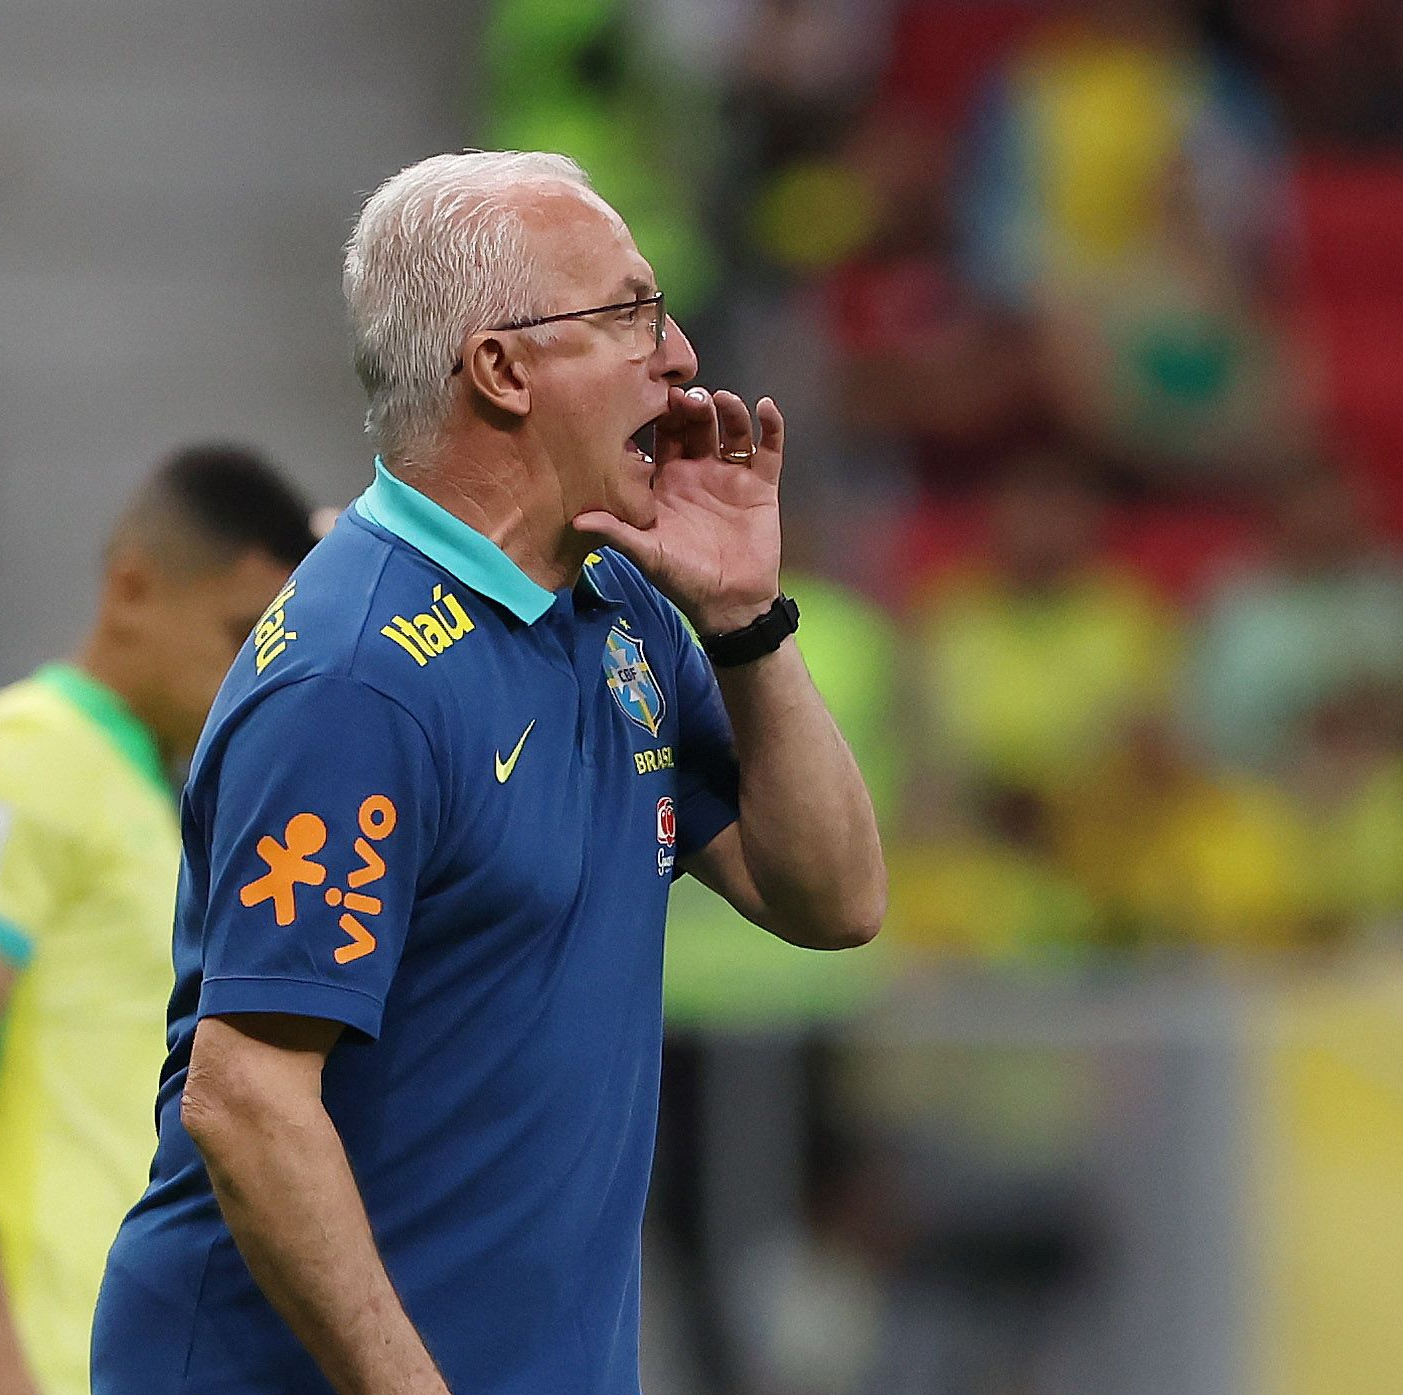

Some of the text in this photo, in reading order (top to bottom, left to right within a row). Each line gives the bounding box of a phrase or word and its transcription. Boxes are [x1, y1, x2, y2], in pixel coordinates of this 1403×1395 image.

[380, 584, 475, 667] Itaú
[618, 666, 637, 682] CBF
[634, 746, 675, 775] BRASIL
[324, 794, 397, 965] vivo
